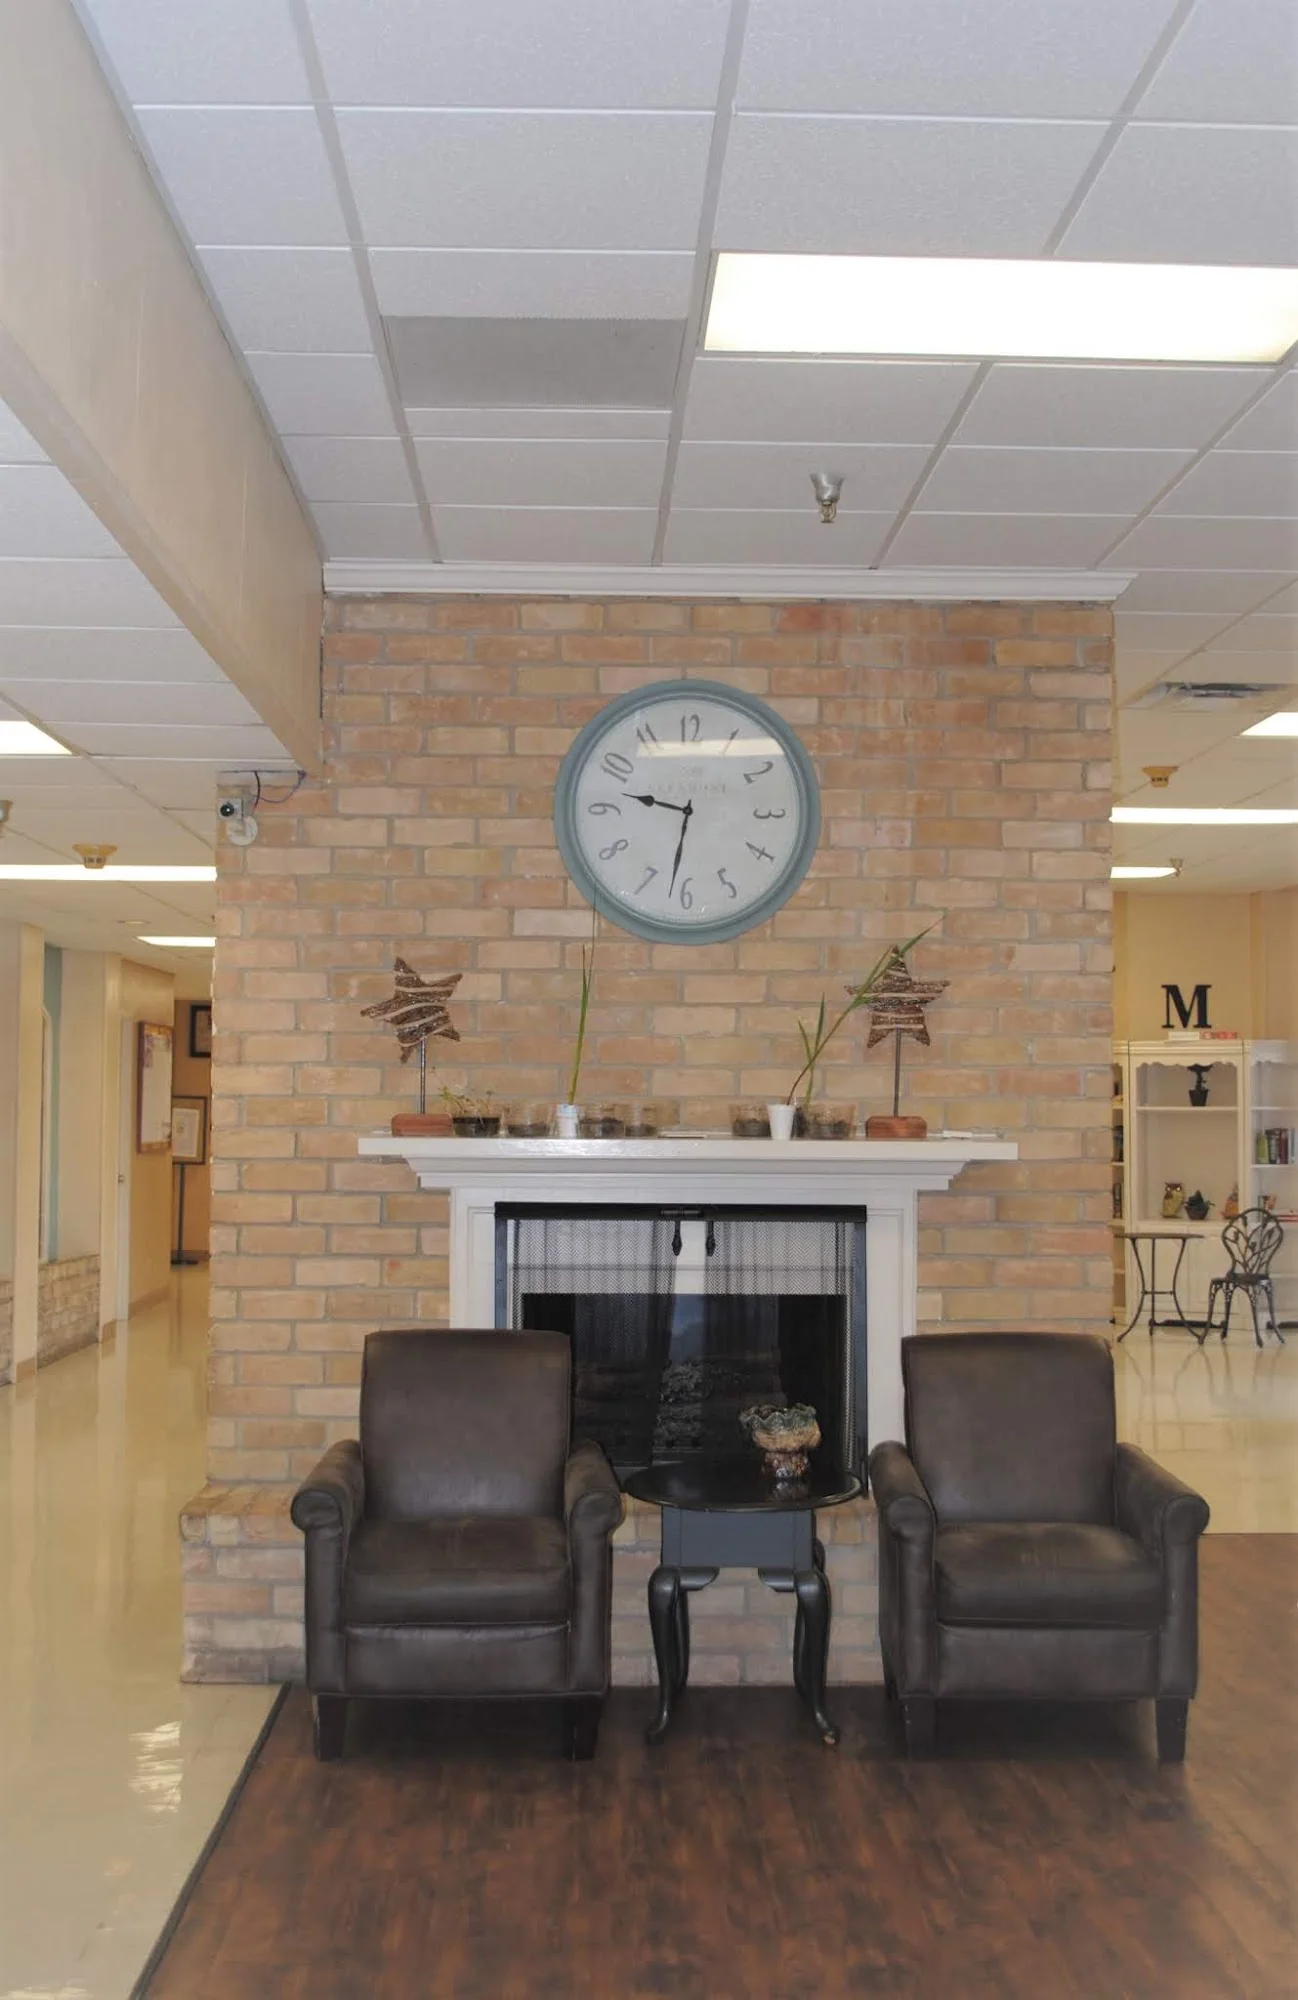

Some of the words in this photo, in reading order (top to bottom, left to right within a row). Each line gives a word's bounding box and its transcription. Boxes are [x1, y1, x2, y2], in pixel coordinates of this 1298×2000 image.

[636, 723, 664, 756] 11
[680, 714, 702, 745] 12
[722, 728, 740, 758] 1
[600, 752, 634, 784] 10
[743, 761, 774, 784] 2
[588, 802, 622, 816] 9
[752, 808, 786, 820] 3
[598, 839, 629, 861] 8
[745, 841, 775, 863] 4
[633, 866, 659, 895] 7
[680, 877, 694, 910] 6
[717, 868, 737, 899] 5
[1160, 983, 1213, 1030] M
